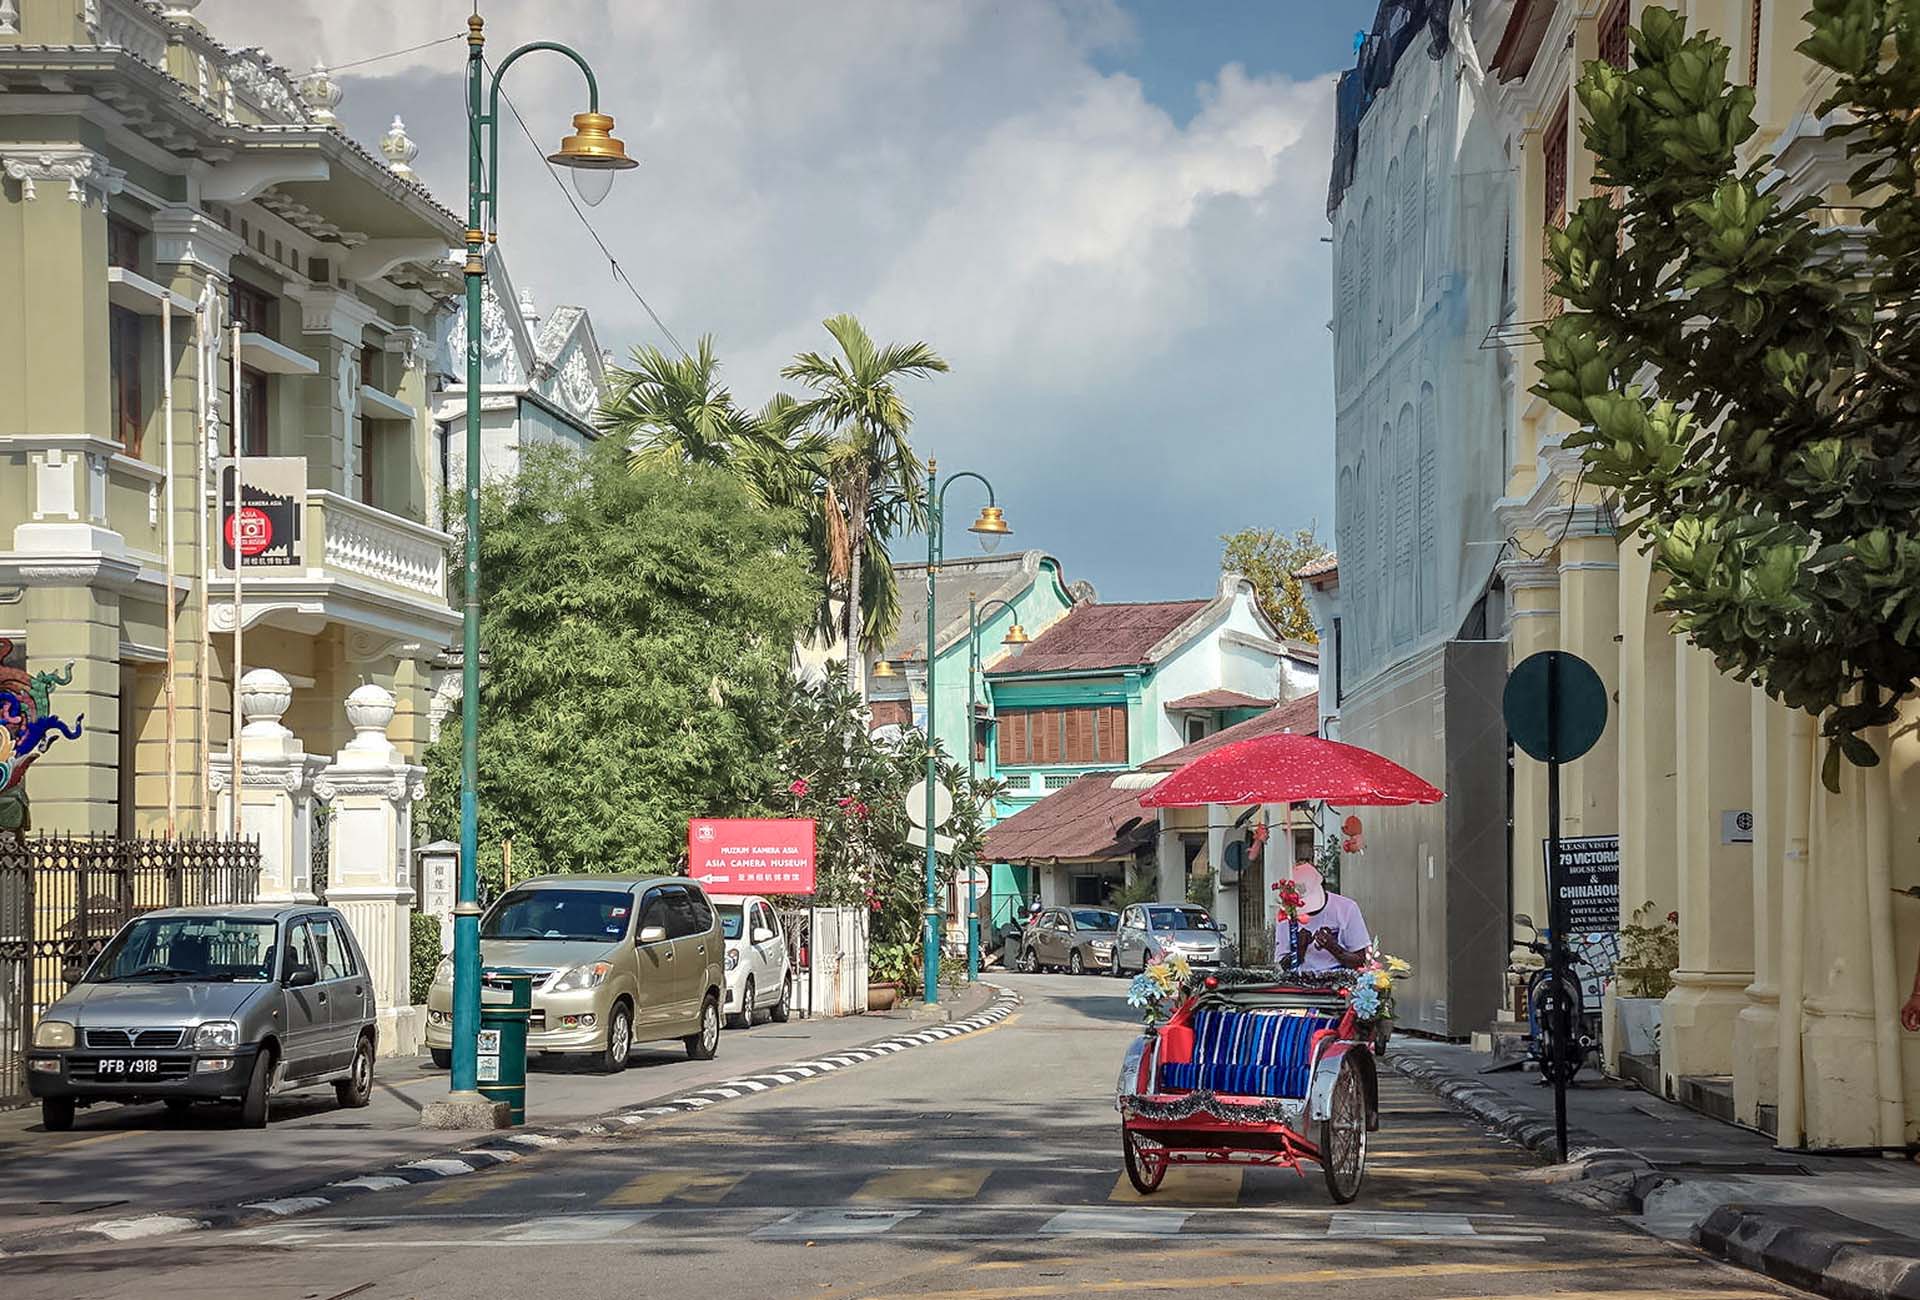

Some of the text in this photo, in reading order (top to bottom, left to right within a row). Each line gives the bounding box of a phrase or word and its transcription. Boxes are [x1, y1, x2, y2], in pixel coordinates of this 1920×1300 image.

[1588, 841, 1609, 849] VISIT
[705, 859, 807, 867] ASIA CAMERA MUSEUM
[1560, 853, 1573, 865] 79
[1569, 866, 1597, 874] HOUSE
[1590, 874, 1599, 884] &
[1560, 884, 1618, 898] CHINAHOU
[99, 1059, 125, 1073] PFB
